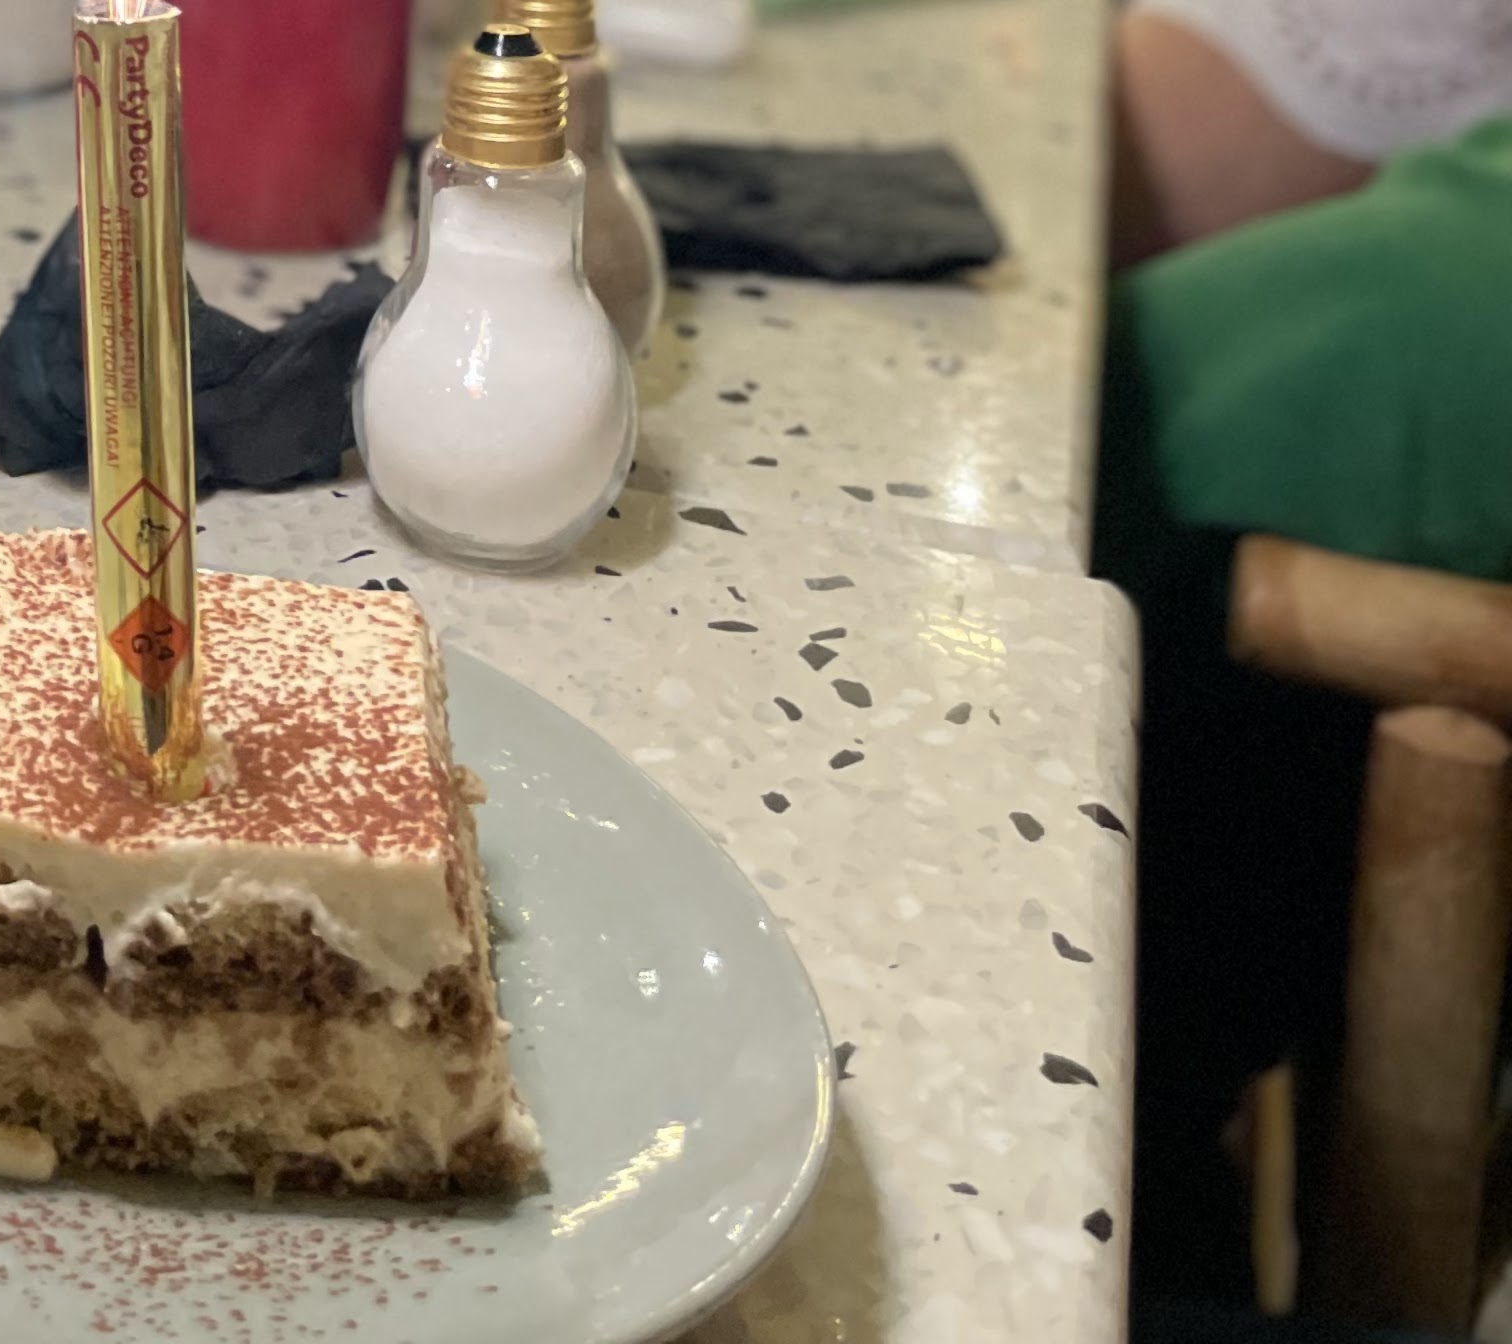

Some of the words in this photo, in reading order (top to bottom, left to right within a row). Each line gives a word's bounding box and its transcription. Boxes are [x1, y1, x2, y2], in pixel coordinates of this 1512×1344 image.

[118, 34, 153, 199] PartyDeco
[99, 205, 116, 318] ATTENZIONE!
[101, 323, 118, 390] POZOR!
[120, 314, 138, 409] ACHTUNG!
[104, 396, 120, 468] UWAGA!
[132, 634, 153, 654] G
[155, 624, 175, 661] 1.4
